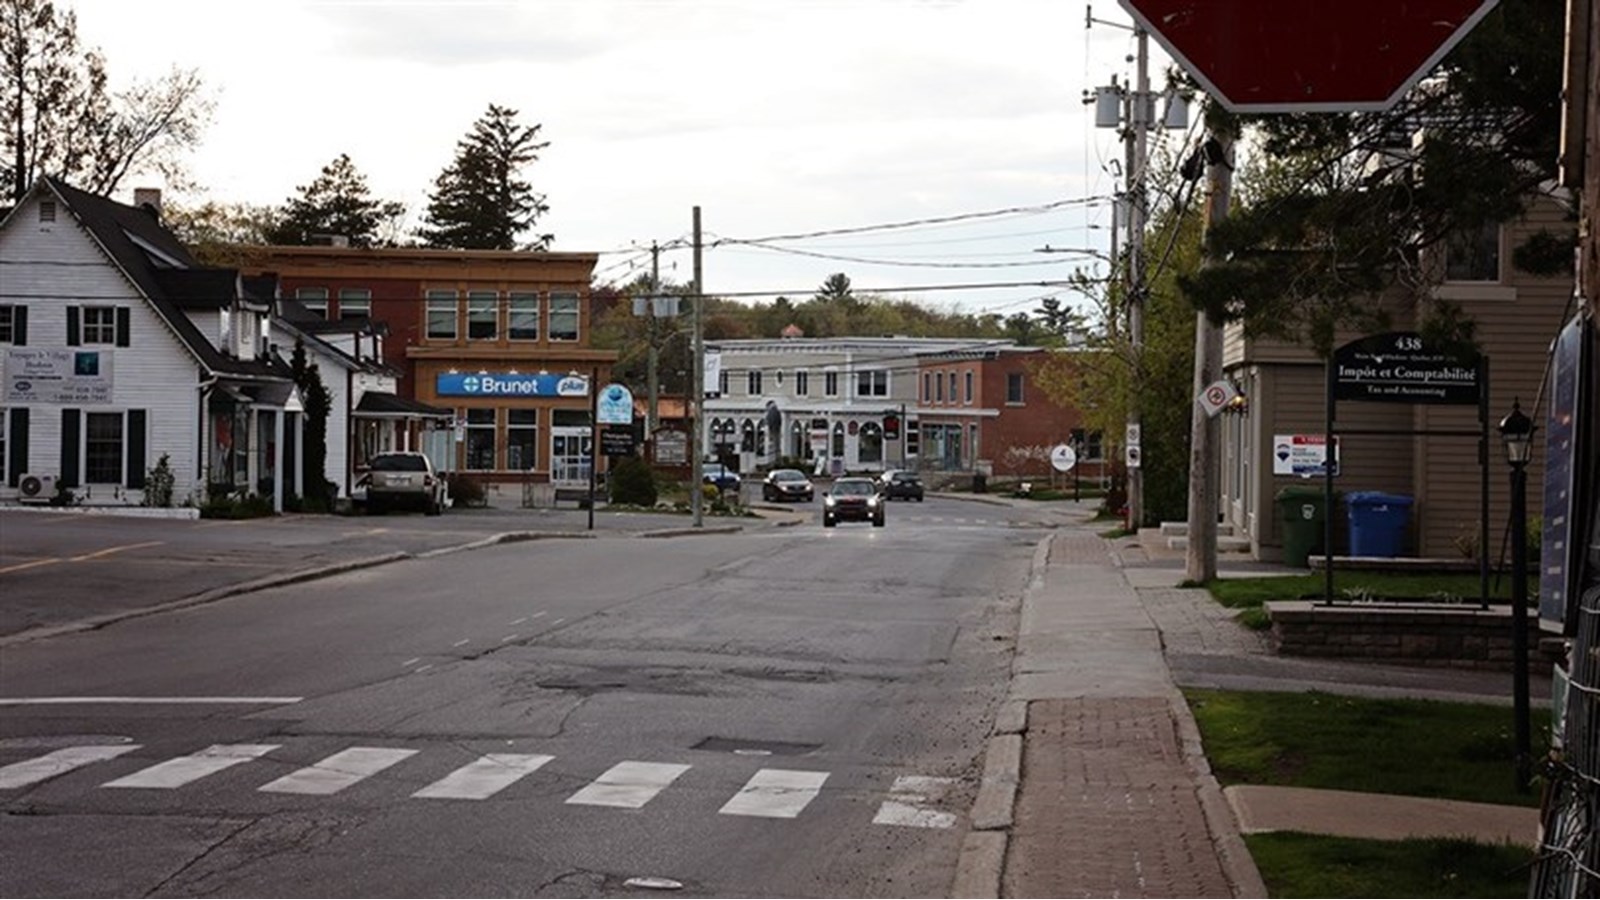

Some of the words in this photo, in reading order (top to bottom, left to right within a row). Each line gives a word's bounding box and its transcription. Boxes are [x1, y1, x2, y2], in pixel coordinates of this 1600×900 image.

[1395, 336, 1423, 350] 438
[1338, 365, 1377, 381] Impôt
[1379, 367, 1391, 378] et
[1394, 365, 1477, 383] Comptabilité
[482, 377, 538, 394] Brunet
[560, 380, 586, 393] plus
